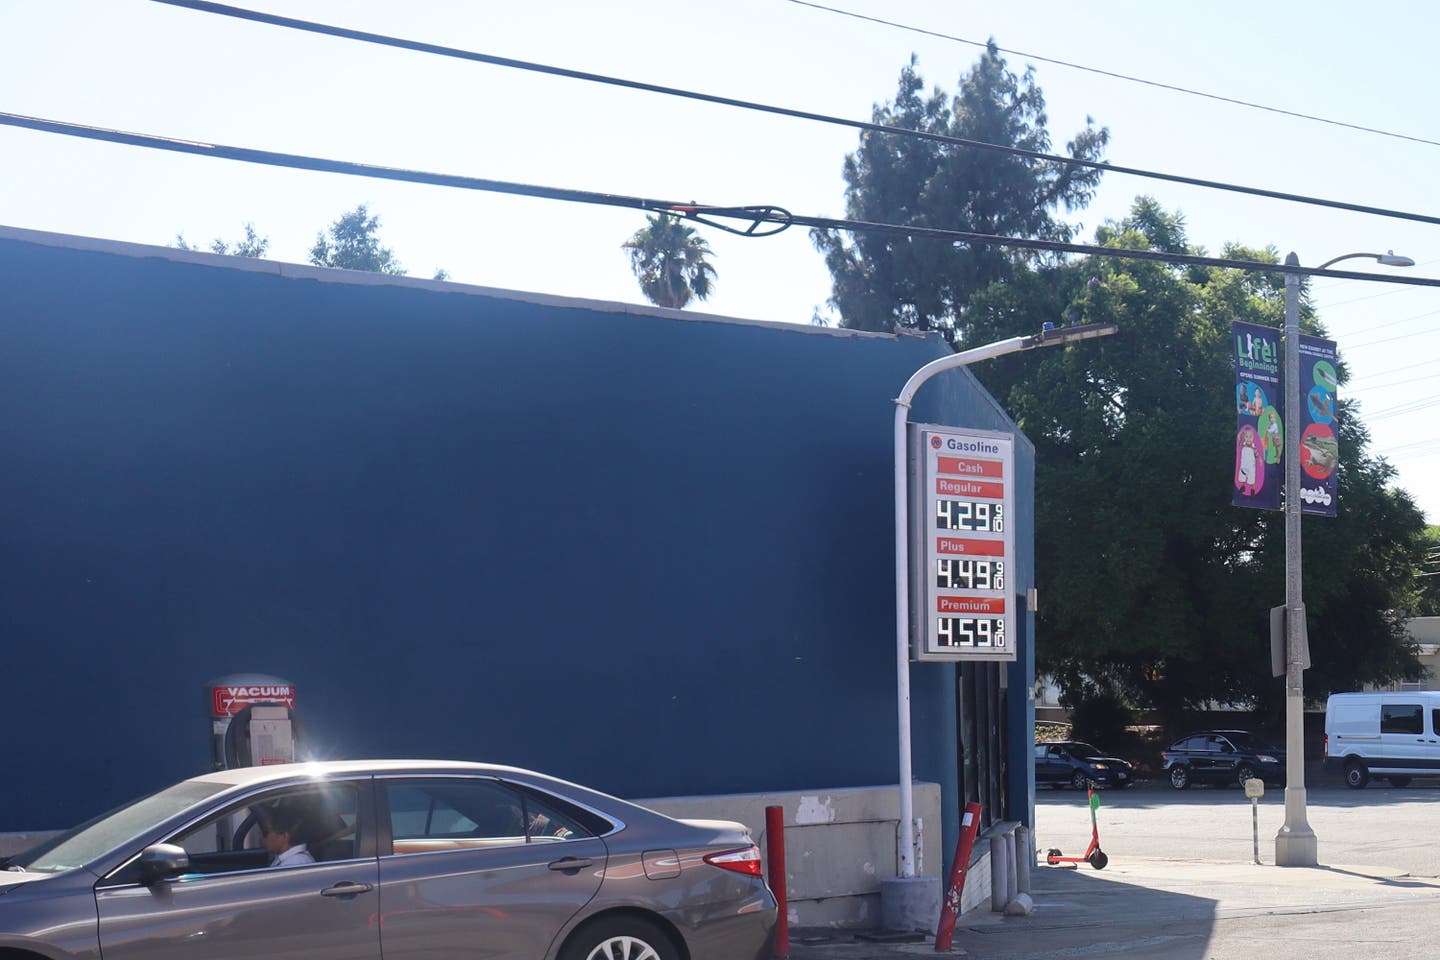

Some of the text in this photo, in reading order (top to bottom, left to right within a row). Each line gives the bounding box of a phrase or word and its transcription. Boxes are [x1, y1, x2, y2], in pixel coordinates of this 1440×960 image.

[947, 439, 998, 453] Gasoline
[958, 462, 982, 473] Cash
[940, 480, 982, 493] Regular
[937, 500, 990, 530] 4.29
[940, 541, 964, 551] Plus
[938, 560, 990, 589] 4.49
[941, 600, 990, 610] Premium
[938, 618, 991, 646] 4.59
[228, 687, 290, 696] VACUUM
